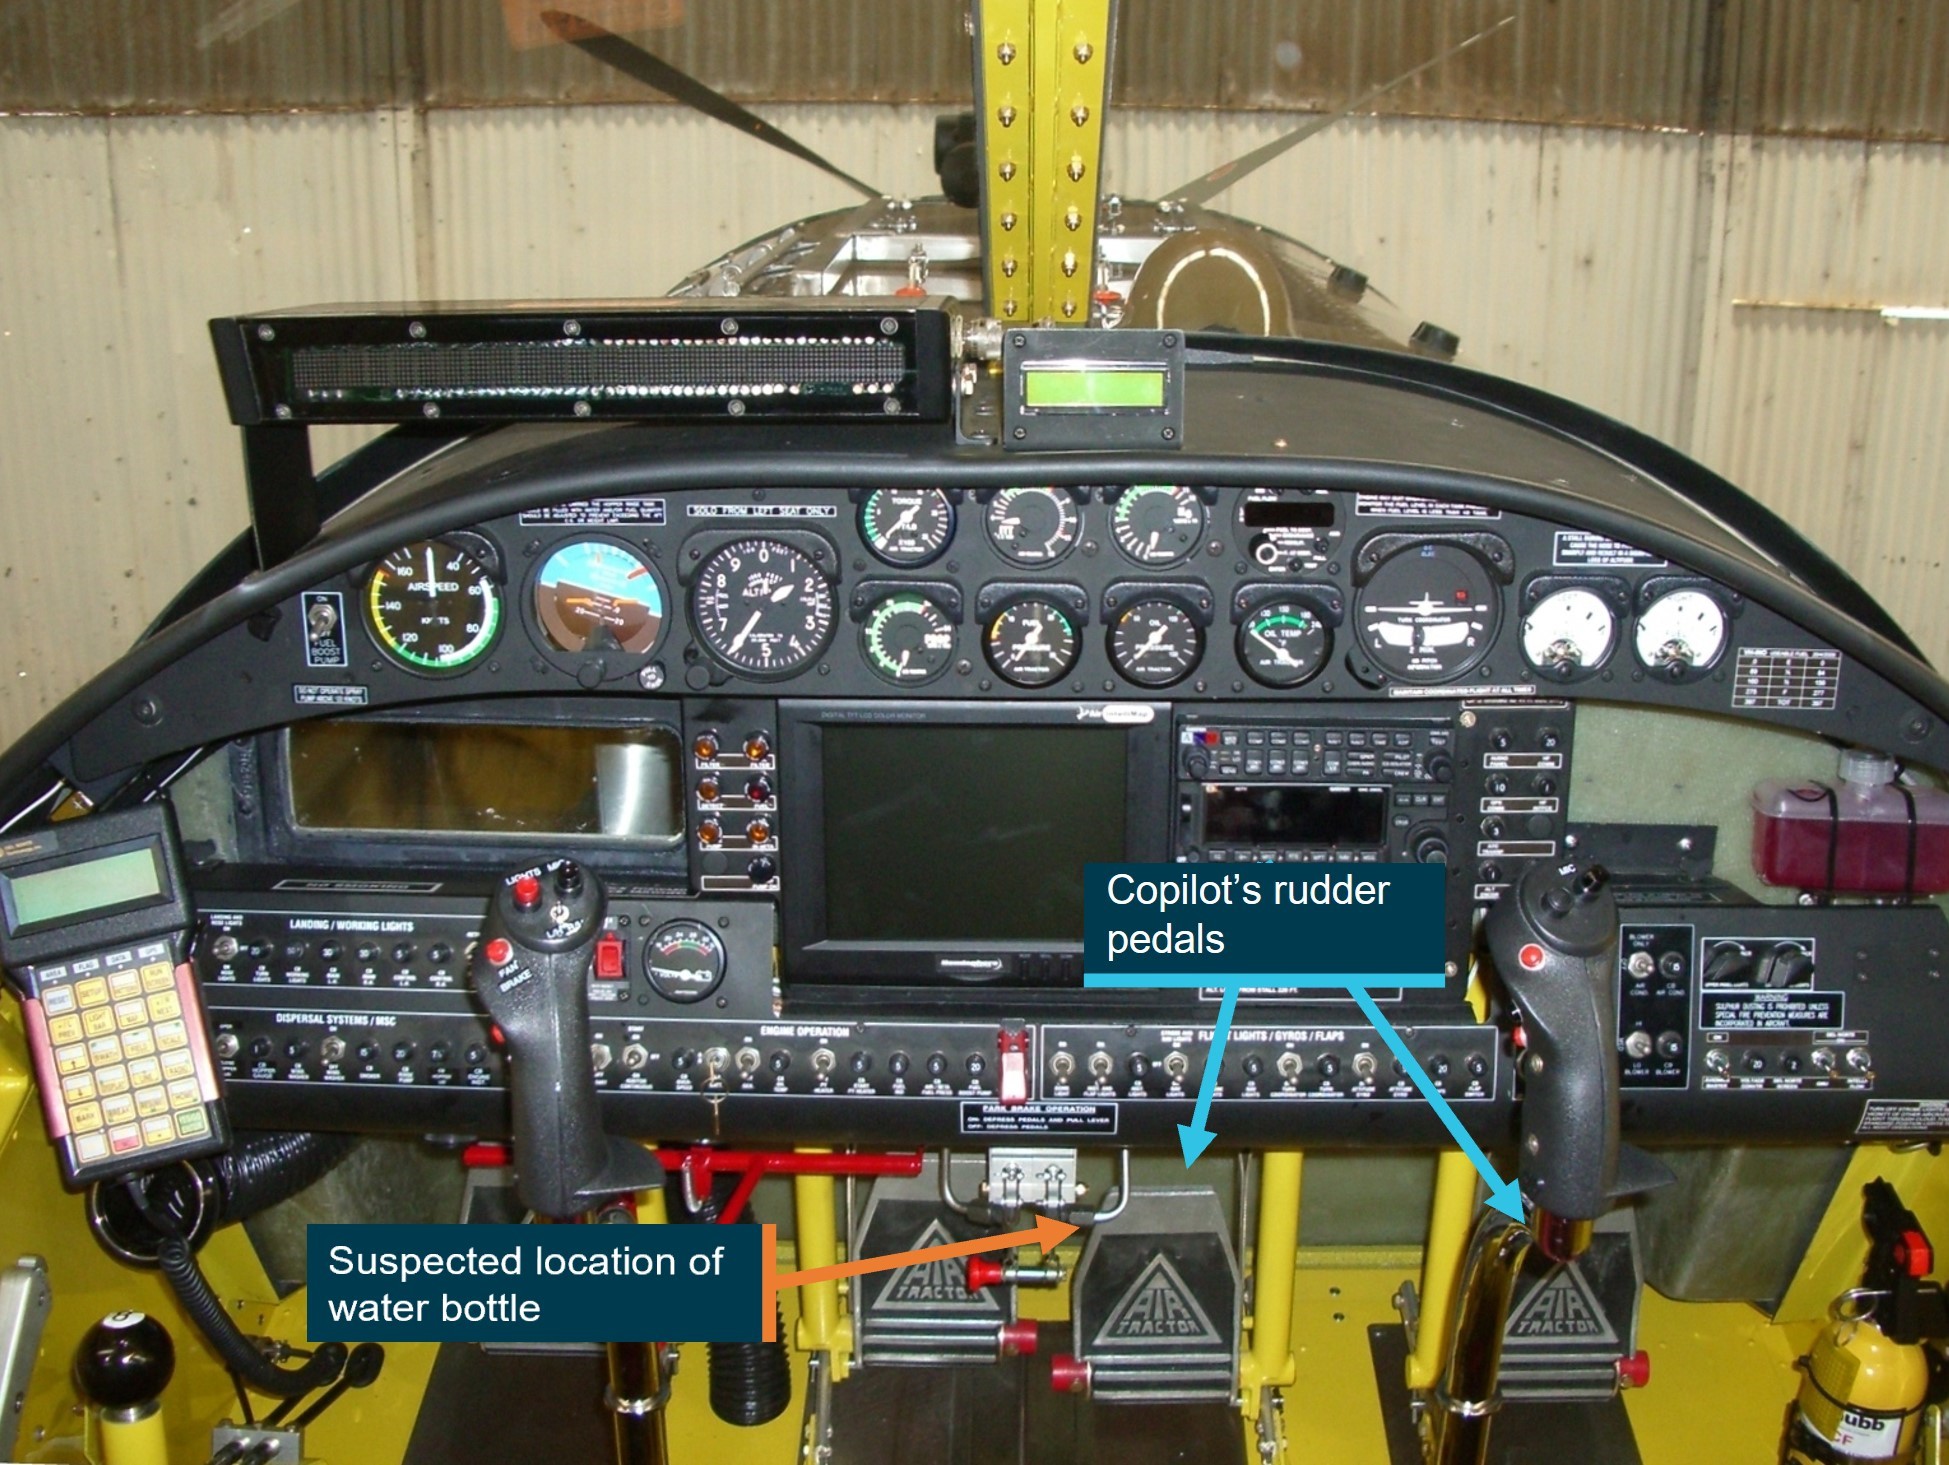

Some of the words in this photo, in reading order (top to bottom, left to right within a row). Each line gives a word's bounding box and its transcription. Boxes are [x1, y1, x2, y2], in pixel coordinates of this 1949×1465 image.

[695, 507, 716, 515] SOLO
[723, 507, 747, 515] FROM
[753, 507, 770, 515] LEFT
[780, 507, 800, 515] SEAT
[807, 507, 829, 515] ONLY
[759, 548, 769, 563] 0
[447, 562, 459, 571] 40
[730, 557, 741, 572] 9
[397, 567, 413, 576] 160
[717, 574, 726, 587] 8
[804, 577, 814, 592] 2
[468, 587, 481, 595] 60
[385, 602, 401, 610] 140
[719, 617, 727, 631] 7
[805, 615, 815, 630] 3
[466, 624, 479, 633] 80
[402, 633, 418, 642] 120
[789, 634, 801, 648] 4
[1374, 638, 1382, 648] L
[1466, 637, 1475, 647] R
[311, 648, 340, 656] BOOST
[761, 642, 771, 657] 5
[314, 656, 340, 664] PUMP
[1546, 739, 1556, 747] 20
[290, 919, 329, 930] LANDING
[336, 920, 379, 931] WORKING
[381, 921, 414, 932] LIGHTS
[499, 968, 533, 992] BRAKE
[276, 1013, 324, 1024] DISPERSAL
[327, 1014, 369, 1025] SYSTEMS
[376, 1016, 396, 1026] MSC
[760, 1025, 795, 1036] ENGINE
[797, 1026, 849, 1037] OPERATION
[1233, 1031, 1267, 1041] LIGHTS
[1275, 1031, 1307, 1041] GYROS
[1315, 1030, 1344, 1041] FLAPS
[971, 1062, 981, 1071] 20
[1438, 1064, 1448, 1073] 20
[1011, 1105, 1041, 1113] BRAKE
[1045, 1105, 1096, 1113] OPERATION
[1123, 1288, 1192, 1319] AIR
[1532, 1289, 1585, 1320] AIR
[1116, 1319, 1200, 1334] TRACTOR
[1518, 1320, 1599, 1335] TRACTOR
